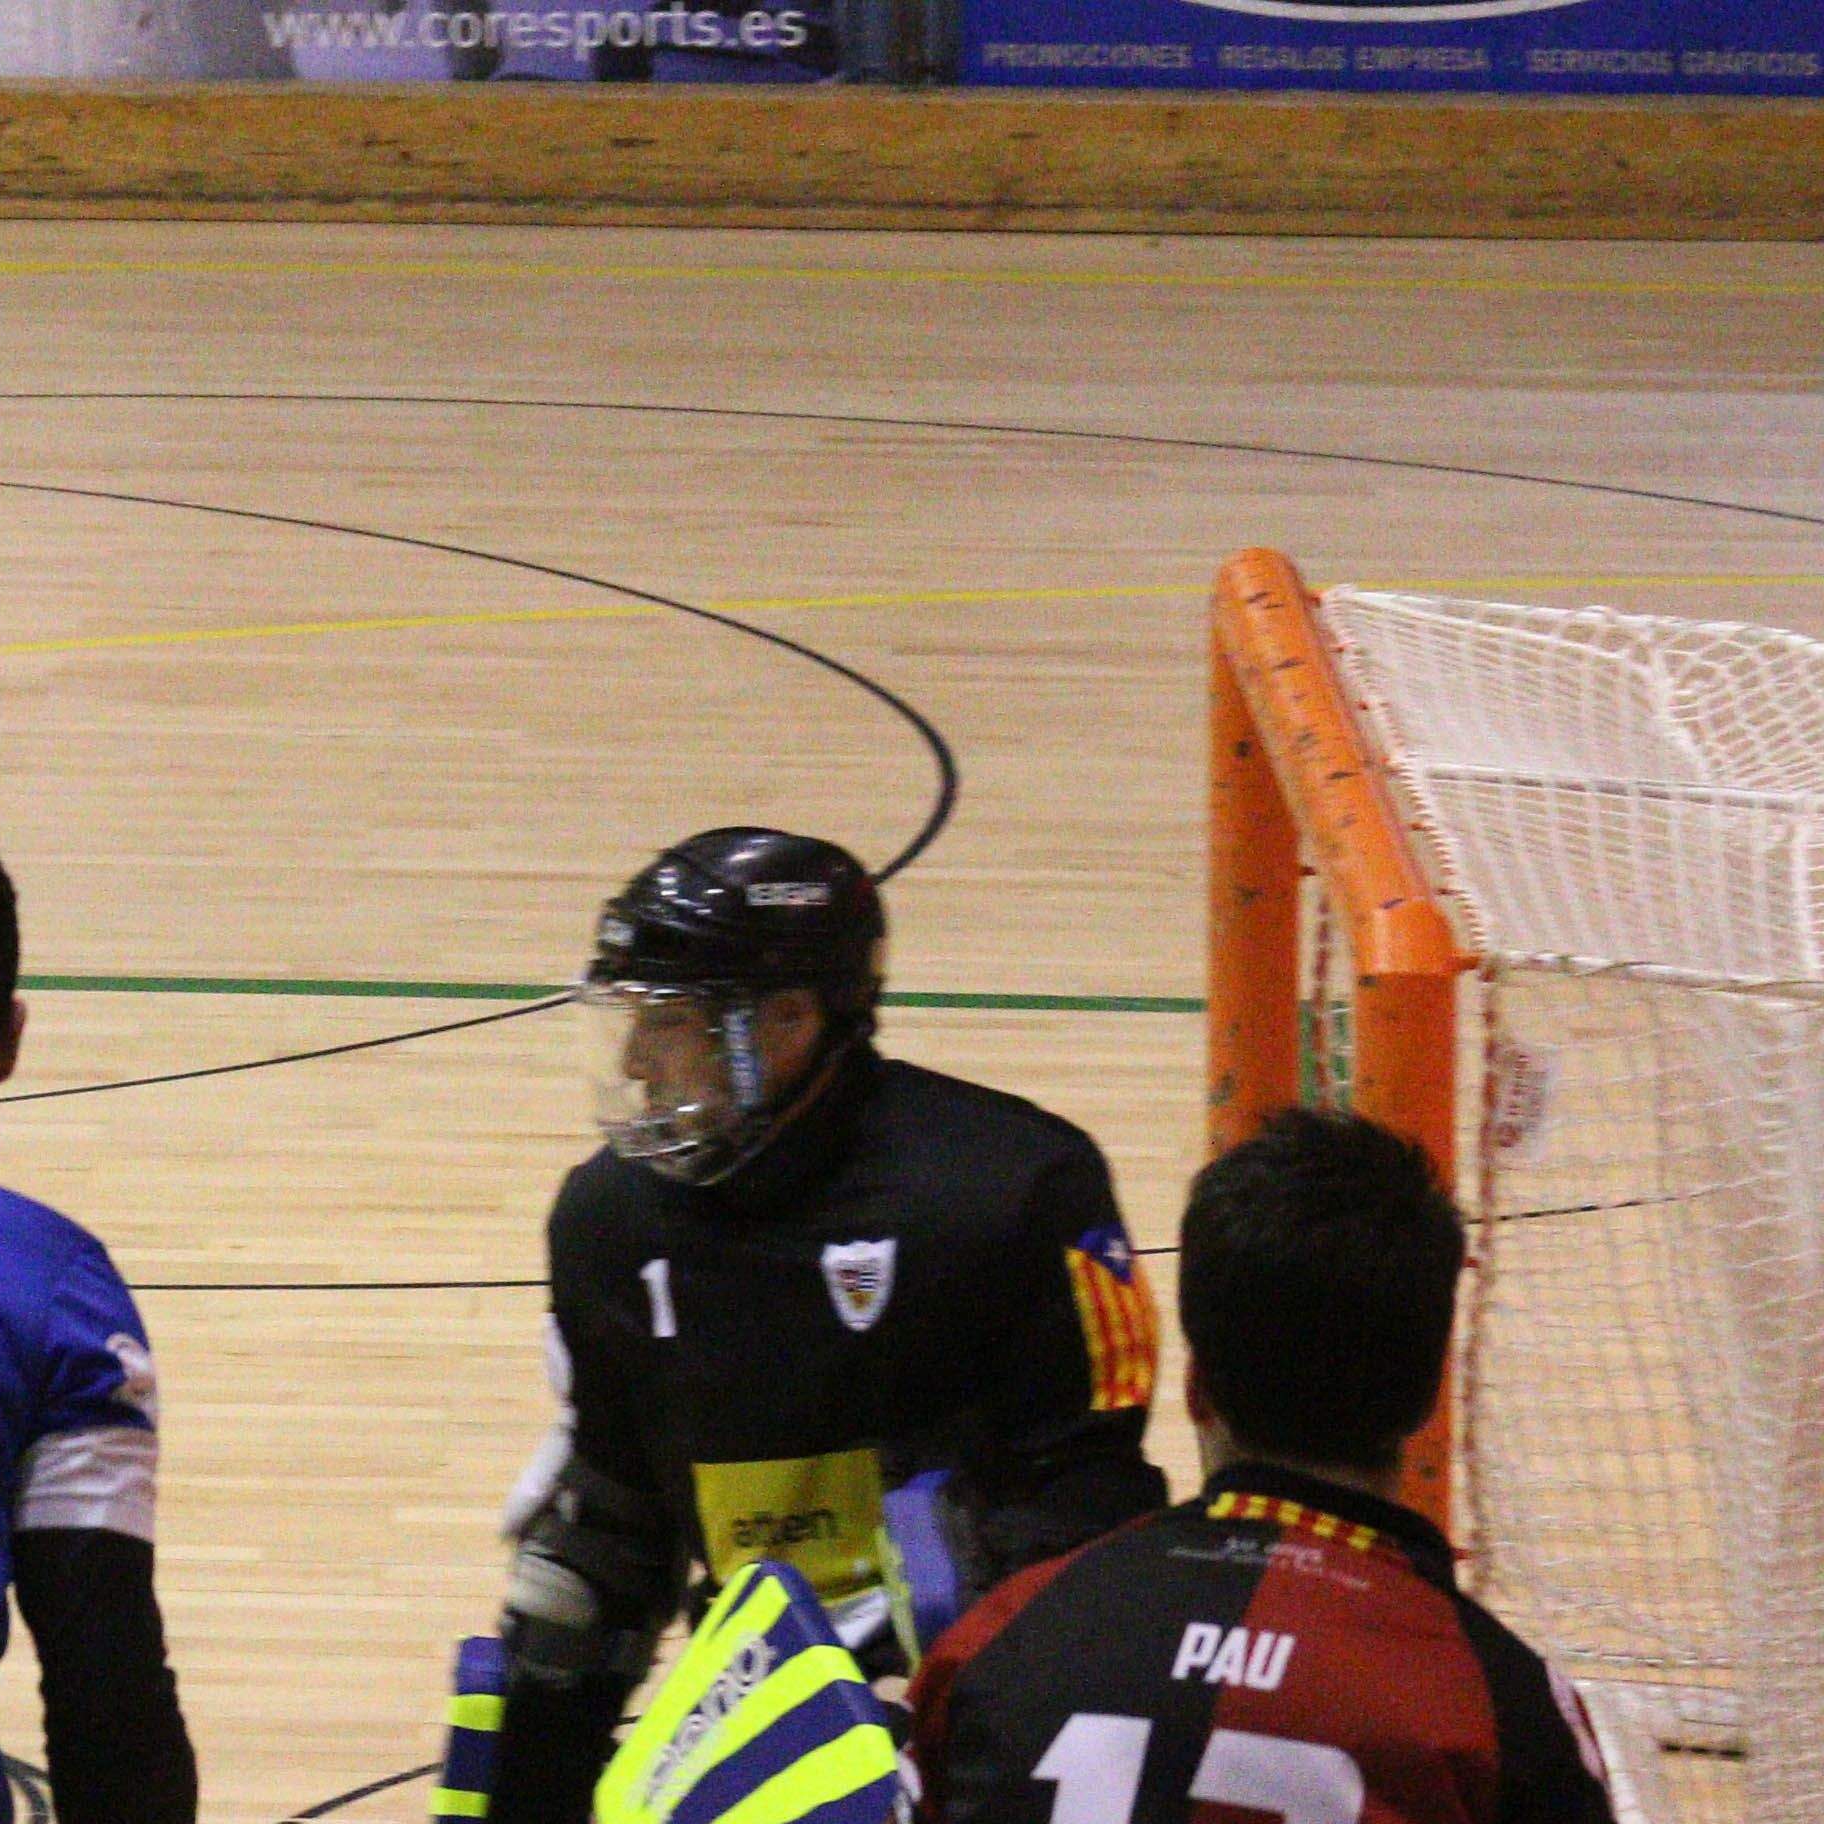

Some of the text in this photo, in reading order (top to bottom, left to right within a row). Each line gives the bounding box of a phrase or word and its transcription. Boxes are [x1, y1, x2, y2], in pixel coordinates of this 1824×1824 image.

[263, 2, 808, 61] www.coresports.es
[639, 1257, 677, 1338] 1
[1170, 1620, 1297, 1692] PAU
